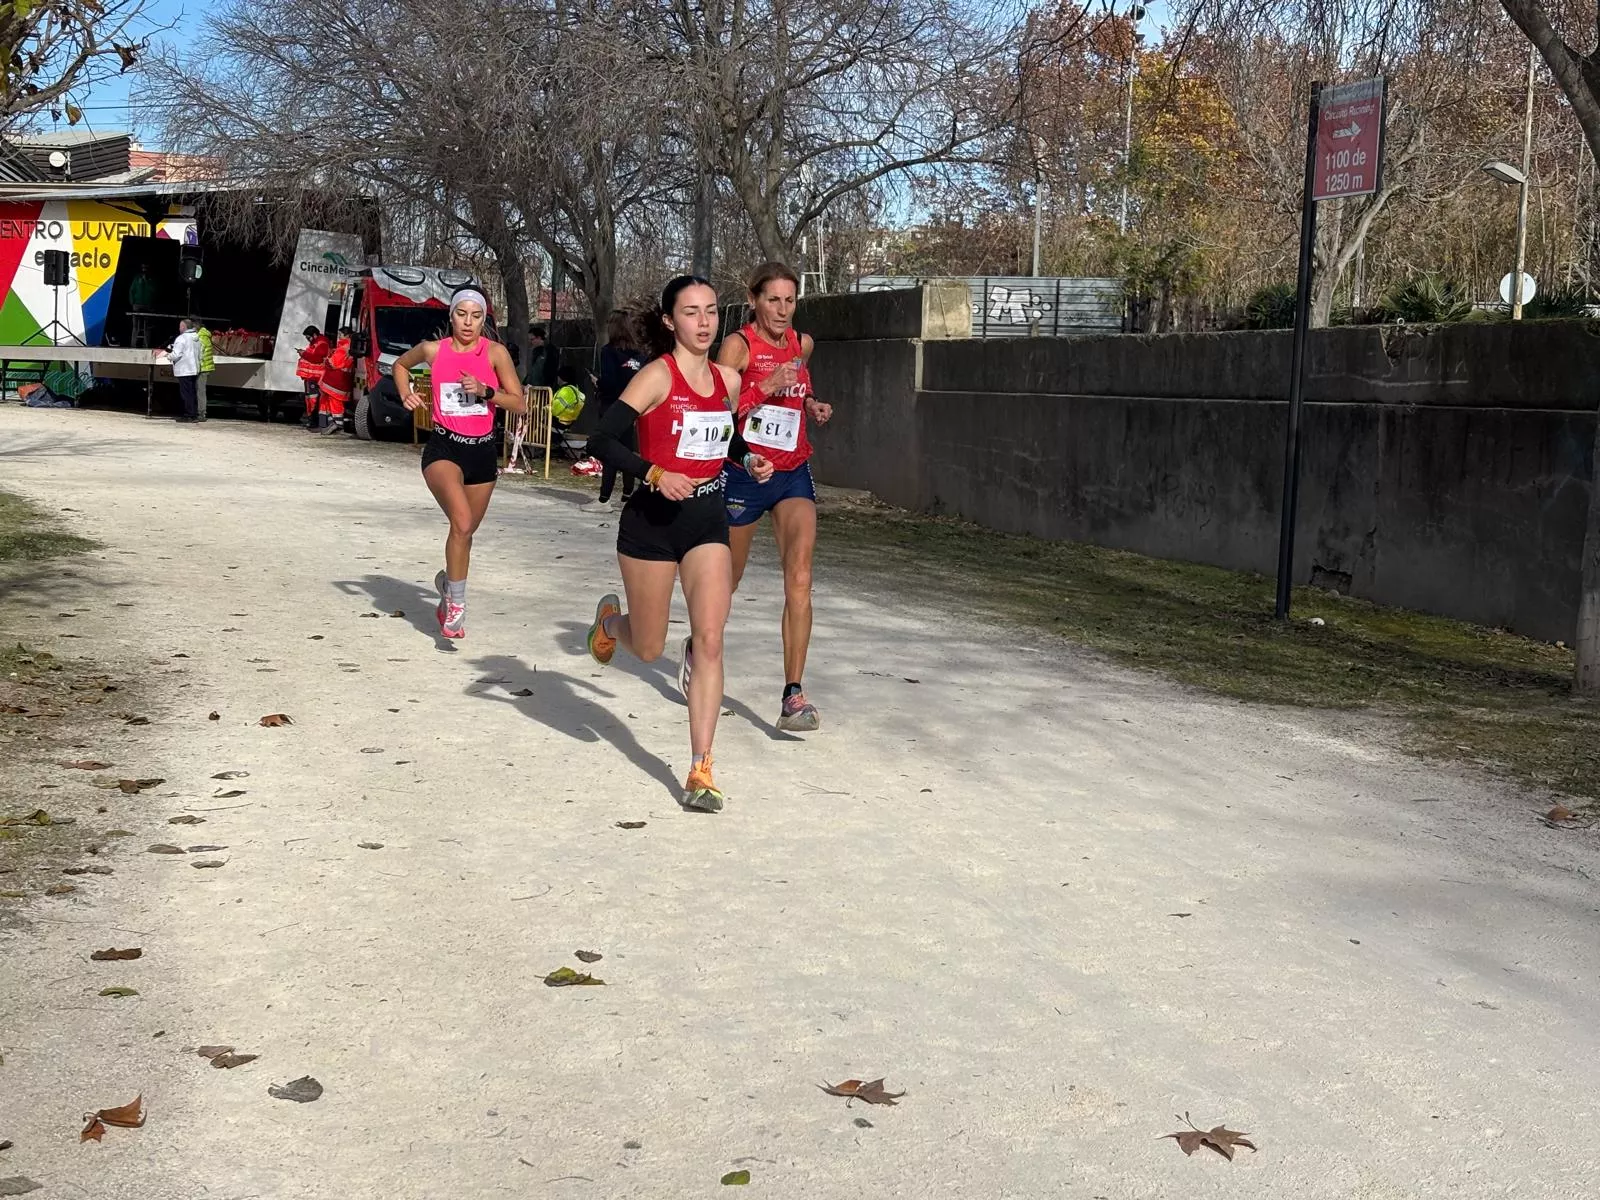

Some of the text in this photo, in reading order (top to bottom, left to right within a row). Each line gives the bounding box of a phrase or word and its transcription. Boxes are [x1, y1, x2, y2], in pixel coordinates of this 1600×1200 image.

[1325, 147, 1367, 170] 1100 de
[1325, 172, 1363, 192] 1250 m
[34, 247, 111, 269] eacio
[457, 391, 469, 403] 21
[705, 426, 719, 442] 10
[765, 422, 780, 436] 13
[449, 433, 478, 445] NIKE
[697, 479, 720, 497] PRO
